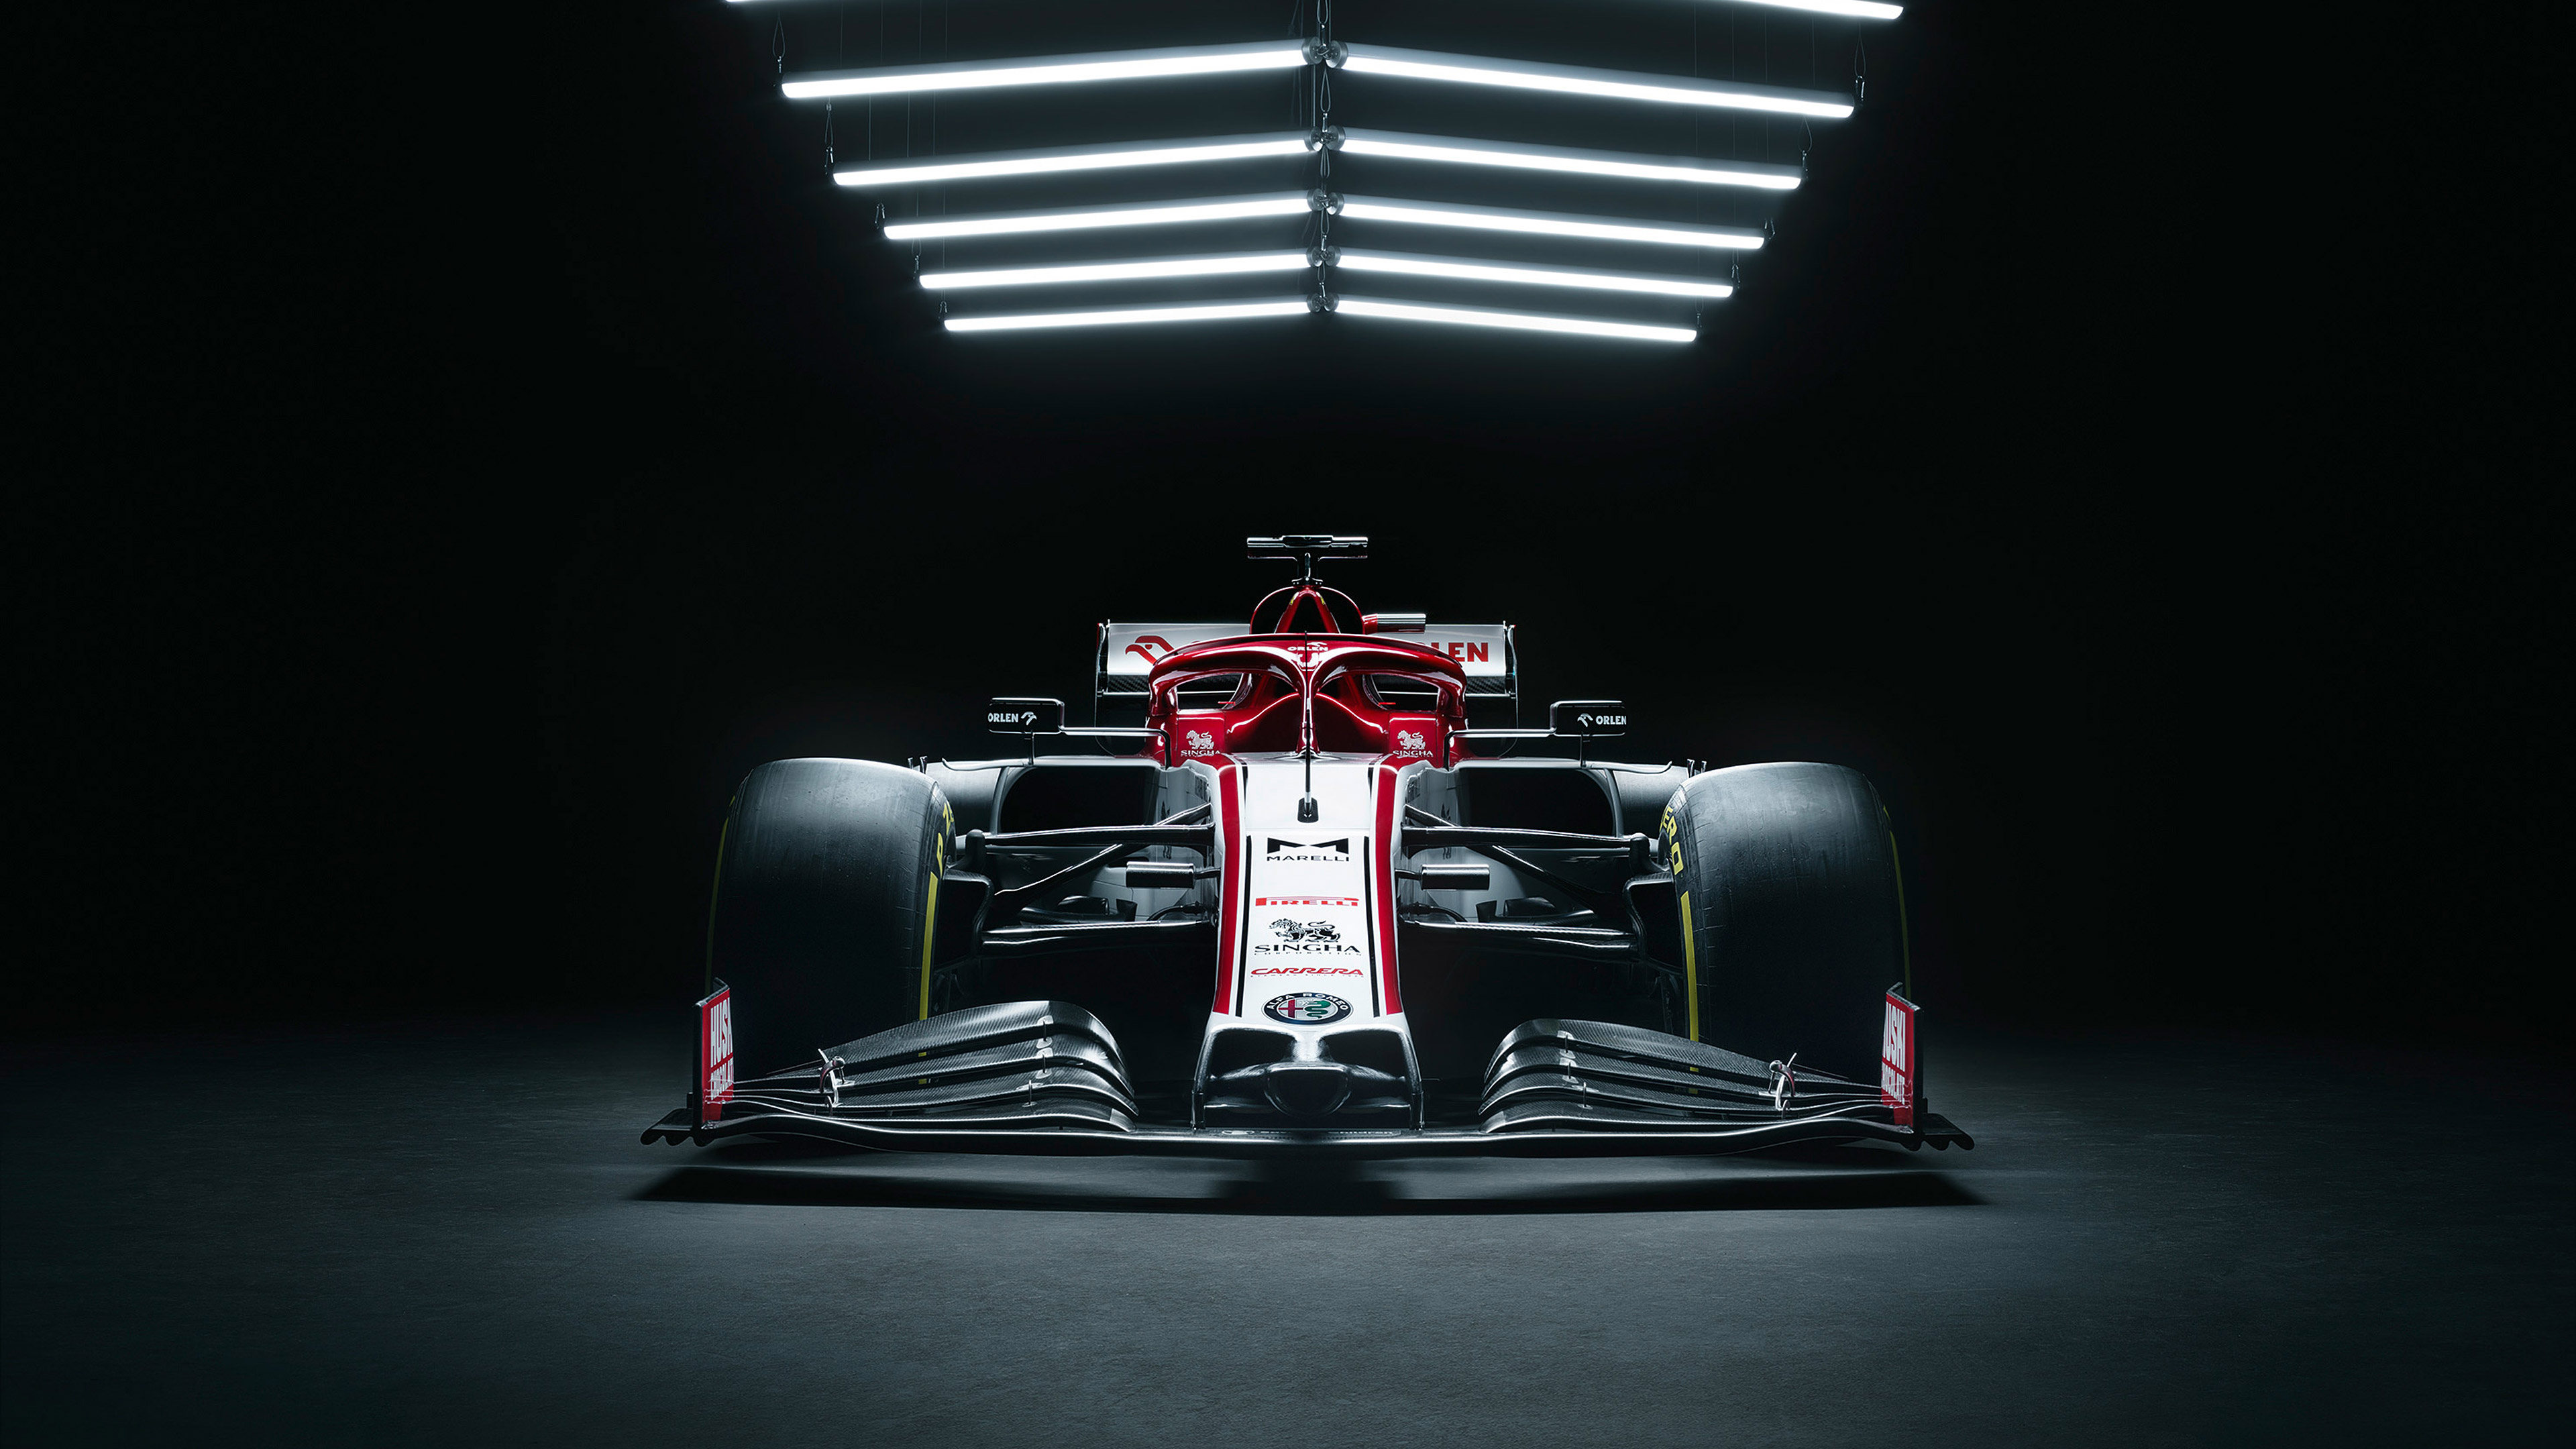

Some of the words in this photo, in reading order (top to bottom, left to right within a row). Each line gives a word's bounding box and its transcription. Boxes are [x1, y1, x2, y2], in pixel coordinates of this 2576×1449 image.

[987, 712, 1019, 723] ORLEN
[1595, 715, 1627, 726] ORLEN
[1255, 896, 1360, 907] PIRELLI
[1254, 943, 1361, 953] SINGHA
[1250, 967, 1364, 976] CARRERA
[1267, 995, 1295, 1010] ALFA
[1302, 993, 1349, 1011] ROMEO
